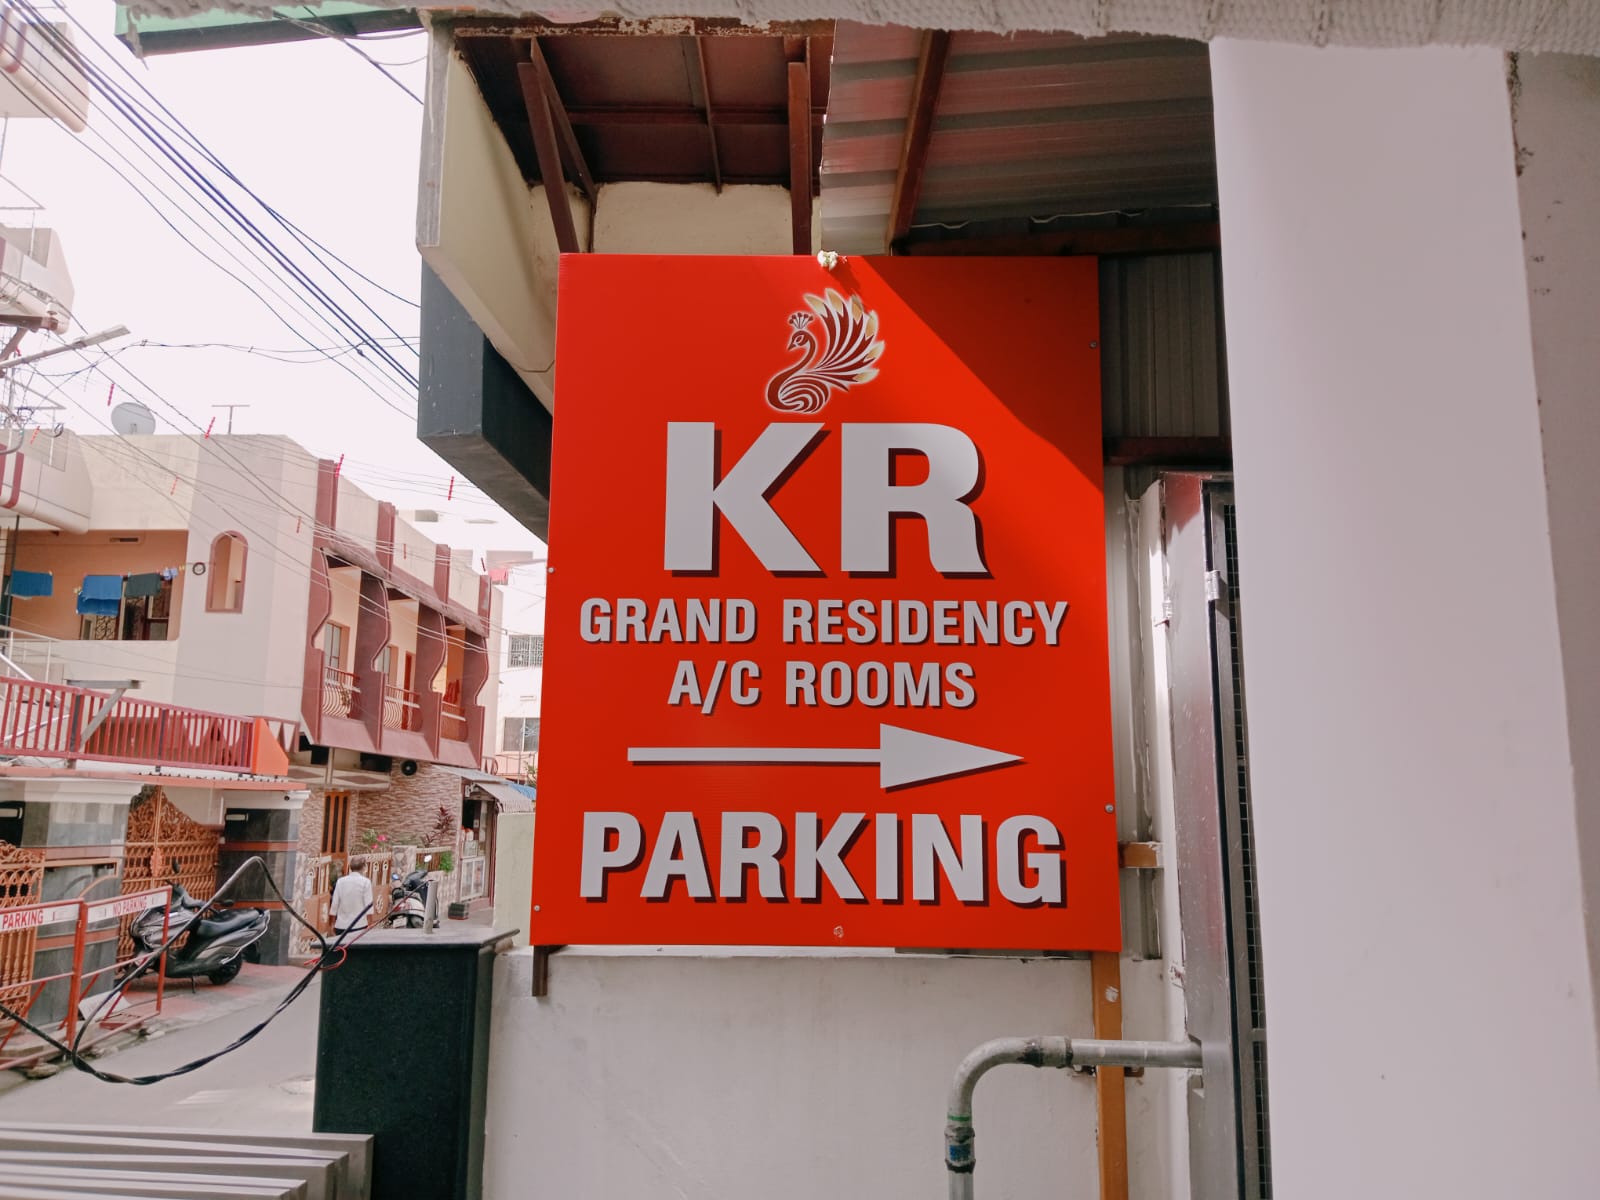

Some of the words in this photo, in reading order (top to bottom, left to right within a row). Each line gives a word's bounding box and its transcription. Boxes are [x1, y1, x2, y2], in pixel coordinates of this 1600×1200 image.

[663, 421, 989, 573] KR
[580, 597, 757, 644] GRAND
[781, 599, 1068, 645] RESIDENCY
[667, 660, 760, 714] A/C
[785, 661, 976, 708] ROOMS
[580, 811, 1063, 905] PARKING
[2, 909, 44, 929] PARKING
